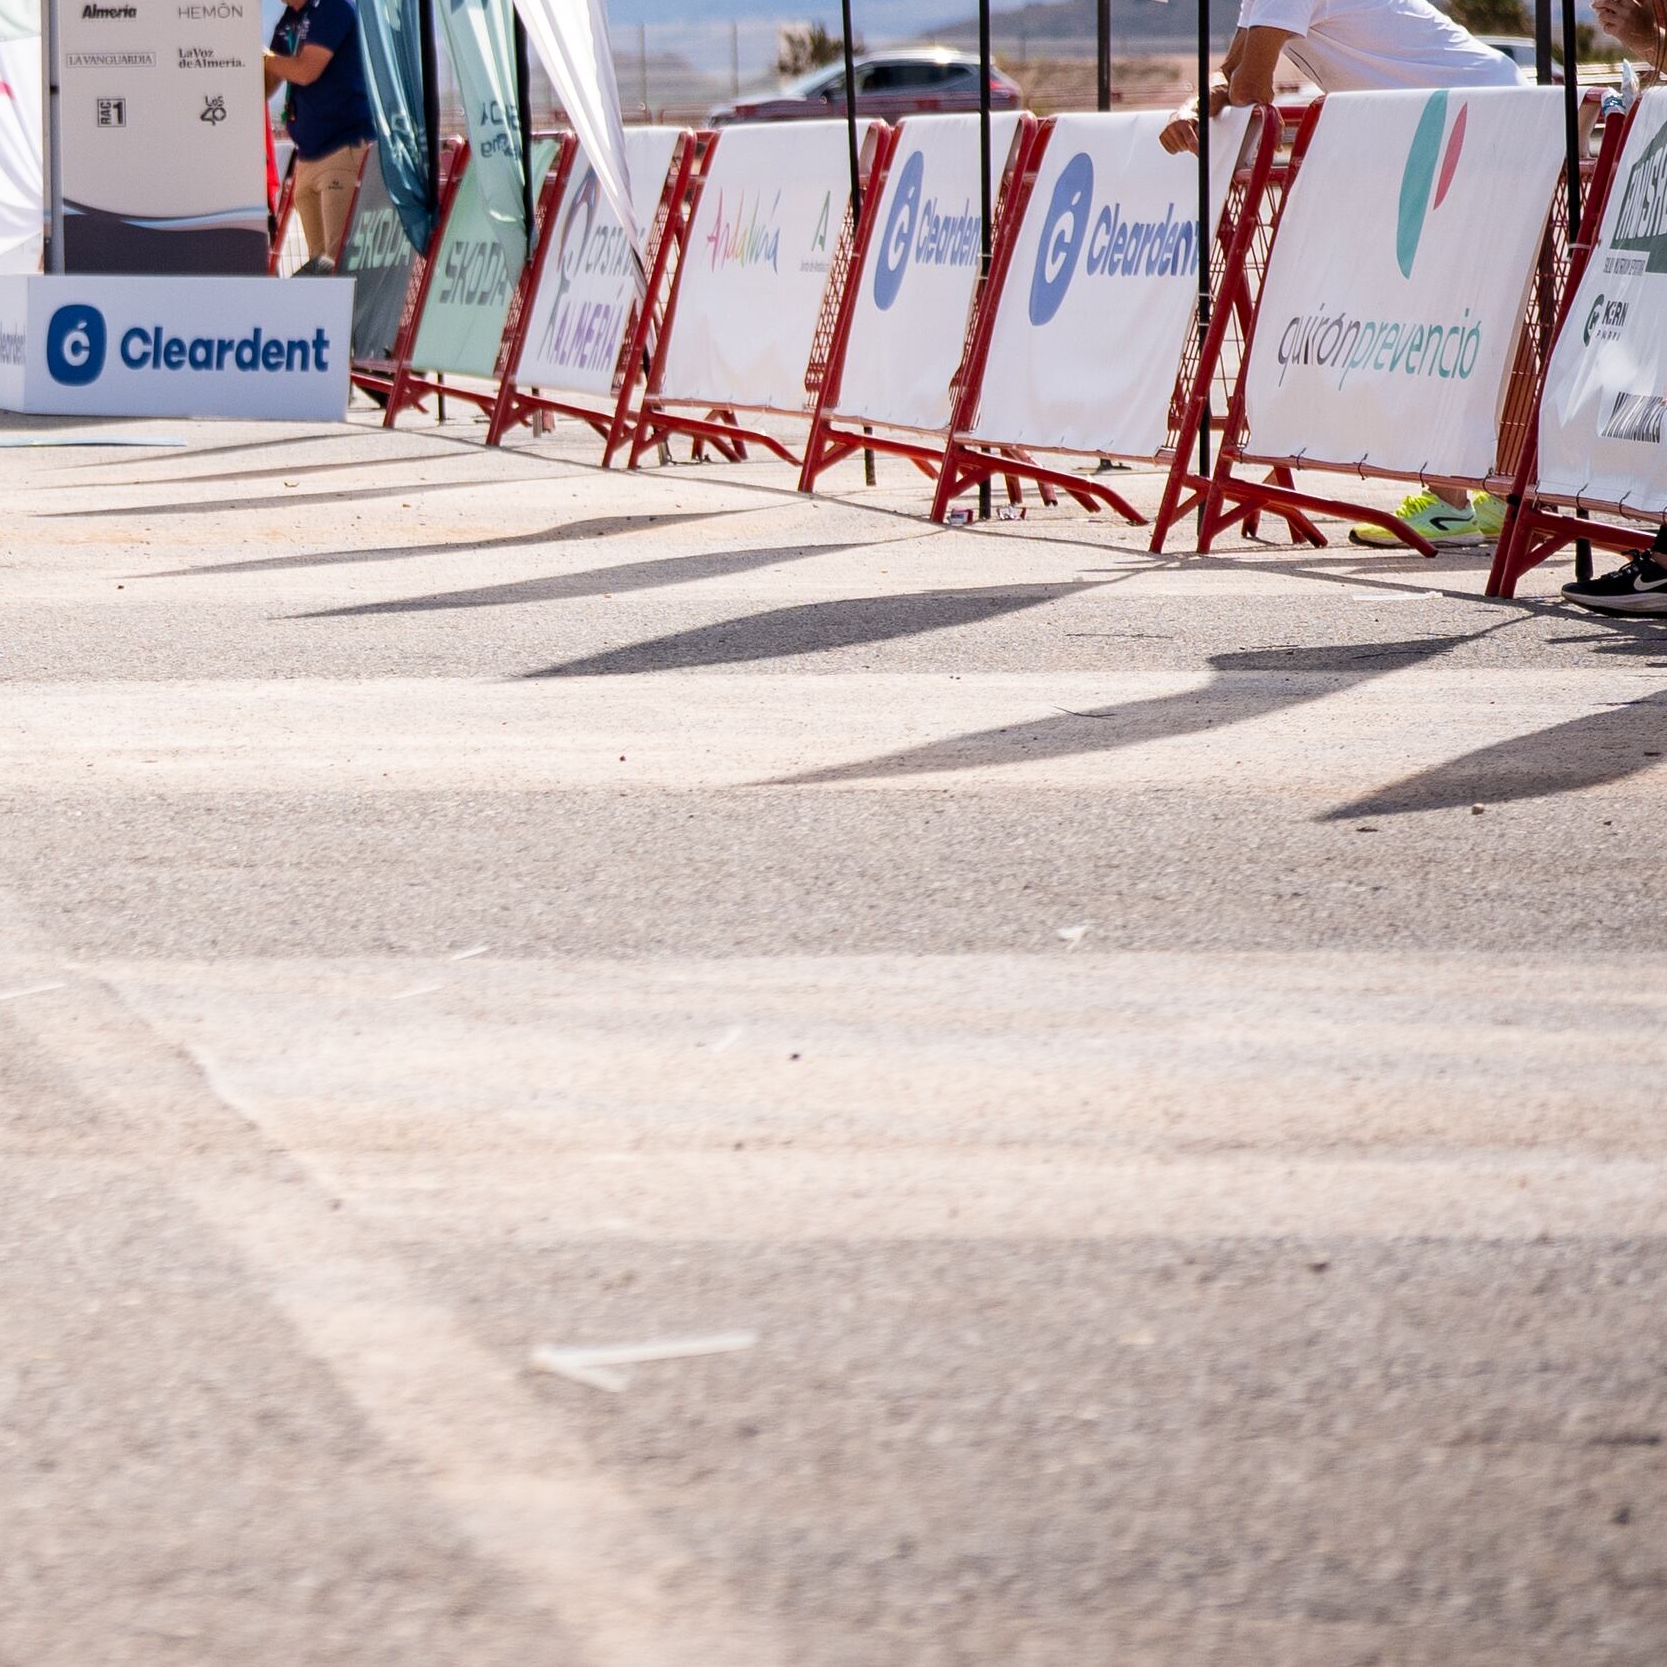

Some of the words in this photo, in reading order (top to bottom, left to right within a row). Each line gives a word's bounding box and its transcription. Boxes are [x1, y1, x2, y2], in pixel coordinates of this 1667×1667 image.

[69, 56, 82, 66] LA
[84, 54, 153, 65] VANGUARDIA
[706, 186, 782, 275] Andalucía
[117, 325, 332, 375] Cleardent
